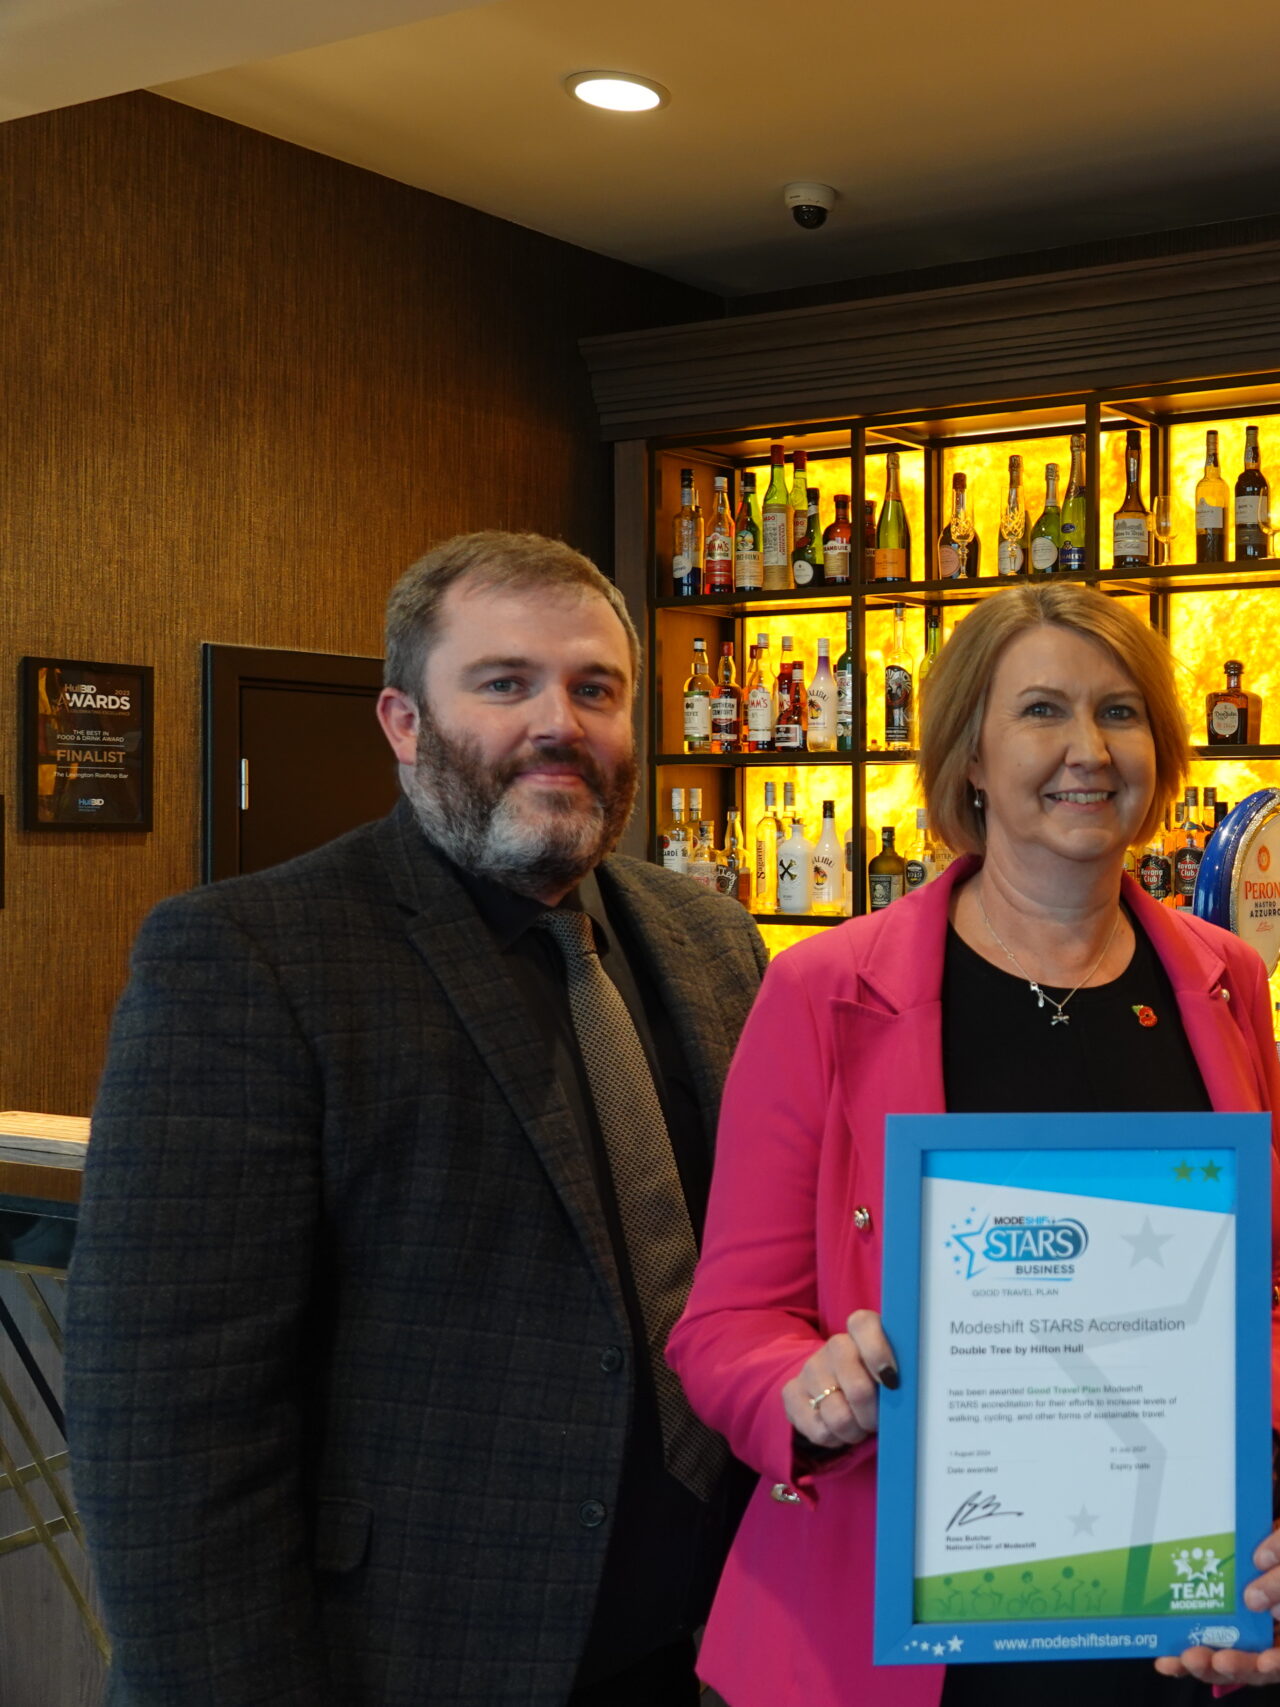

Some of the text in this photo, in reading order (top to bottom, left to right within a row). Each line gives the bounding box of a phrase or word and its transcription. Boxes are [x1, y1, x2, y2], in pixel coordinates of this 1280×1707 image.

[56, 691, 131, 711] AWARDS
[57, 750, 126, 763] FINALIST
[1180, 868, 1195, 877] Club
[988, 1228, 1075, 1259] STARS
[1015, 1265, 1075, 1275] BUSINESS
[972, 1288, 1059, 1297] GOOD TRAVEL PLAN
[950, 1316, 1185, 1335] Modeshift STARS Accreditation
[950, 1344, 1084, 1357] Double Tree by Hilton Hull
[948, 1388, 964, 1396] has
[966, 1388, 987, 1396] been
[1027, 1386, 1051, 1395] Good
[1053, 1386, 1080, 1394] Travel
[1081, 1385, 1101, 1393] Plan
[1103, 1384, 1143, 1393] Modeshift
[949, 1401, 978, 1409] STARS
[981, 1400, 1033, 1408] accreditation
[1035, 1399, 1046, 1407] for
[1049, 1399, 1067, 1407] their
[1069, 1398, 1094, 1406] efforts
[1143, 1397, 1167, 1405] levels
[1169, 1396, 1177, 1404] of
[1083, 1411, 1092, 1419] of
[1094, 1410, 1139, 1418] sustainable
[947, 1466, 998, 1474] Date awarded
[1110, 1462, 1150, 1471] Expiry date
[1170, 1583, 1225, 1600] TEAM
[994, 1634, 1158, 1650] www.modeshiftstars.org
